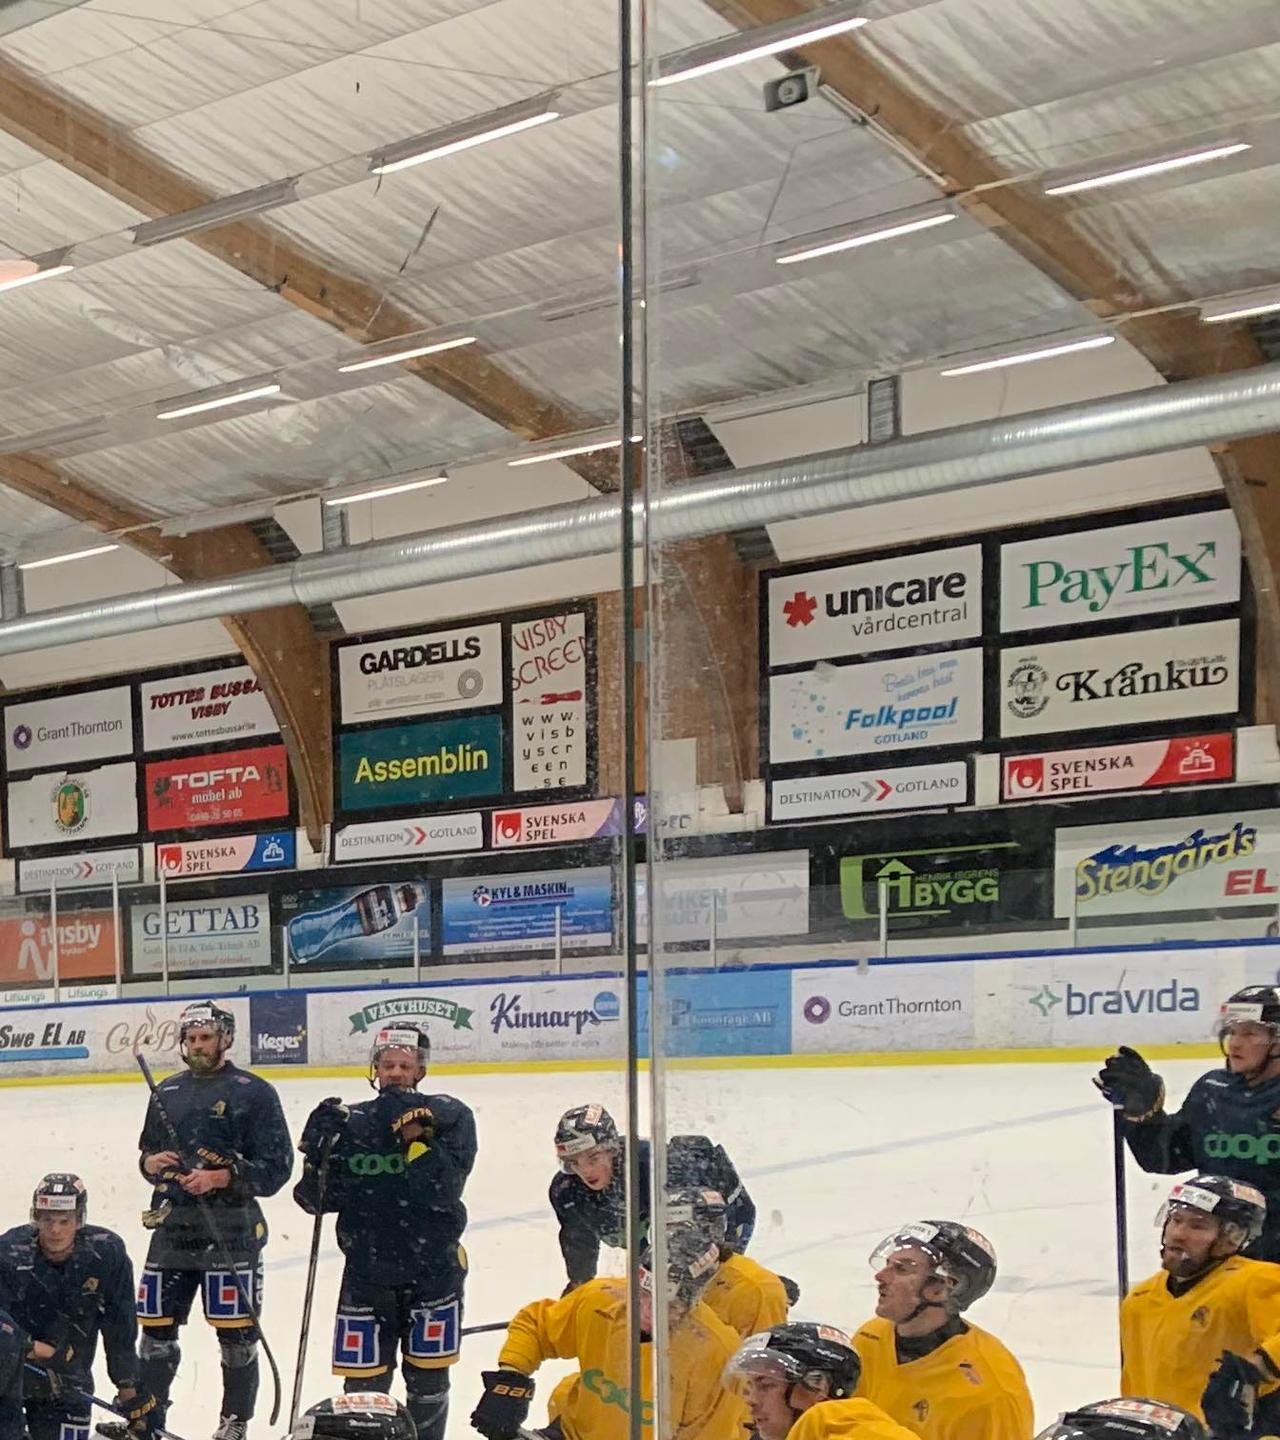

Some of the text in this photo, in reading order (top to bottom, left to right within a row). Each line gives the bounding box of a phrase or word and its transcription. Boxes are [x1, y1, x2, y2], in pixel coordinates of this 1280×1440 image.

[1022, 541, 1216, 612] PayEx
[826, 572, 966, 617] unicare
[853, 601, 968, 636] vårdcentral
[513, 615, 569, 651] VISBY
[360, 636, 481, 675] GARDELLS
[210, 678, 263, 700] BUSSA
[1056, 661, 1228, 702] Kränku
[150, 687, 205, 710] TOTTES
[190, 701, 232, 719] VISBY
[845, 697, 959, 730] Folkpool
[874, 731, 929, 745] GOTLAND
[355, 744, 488, 784] Assemblin
[1050, 755, 1134, 775] SVENSKA
[171, 765, 261, 789] TOFTA
[896, 776, 960, 794] GOTLAND
[1050, 777, 1093, 791] SPEL
[227, 787, 243, 800] ab
[779, 787, 862, 806] DESTINATION
[526, 812, 586, 828] SVENSKA
[341, 831, 404, 848] DESTINATION
[429, 825, 478, 840] GOTLAND
[526, 829, 557, 841] SPEL
[186, 846, 236, 860] SVENSKA
[23, 864, 75, 880] DESTINATION
[96, 859, 135, 873] GOTAND
[186, 860, 211, 872] SPEL
[1075, 826, 1255, 902] Stengårds
[492, 881, 568, 899] KYL & MASKIN
[914, 877, 1000, 907] BYGG
[1224, 868, 1280, 896] EL
[143, 904, 260, 936] GETTAB
[1066, 978, 1200, 1016] bravida
[368, 999, 456, 1020] VÄXTHUSET
[490, 992, 601, 1034] Kinnarps
[40, 1022, 64, 1046] EL
[67, 1030, 86, 1046] AB
[258, 1032, 300, 1052] Keges
[350, 1153, 409, 1178] coo
[493, 1382, 534, 1400] BAU
